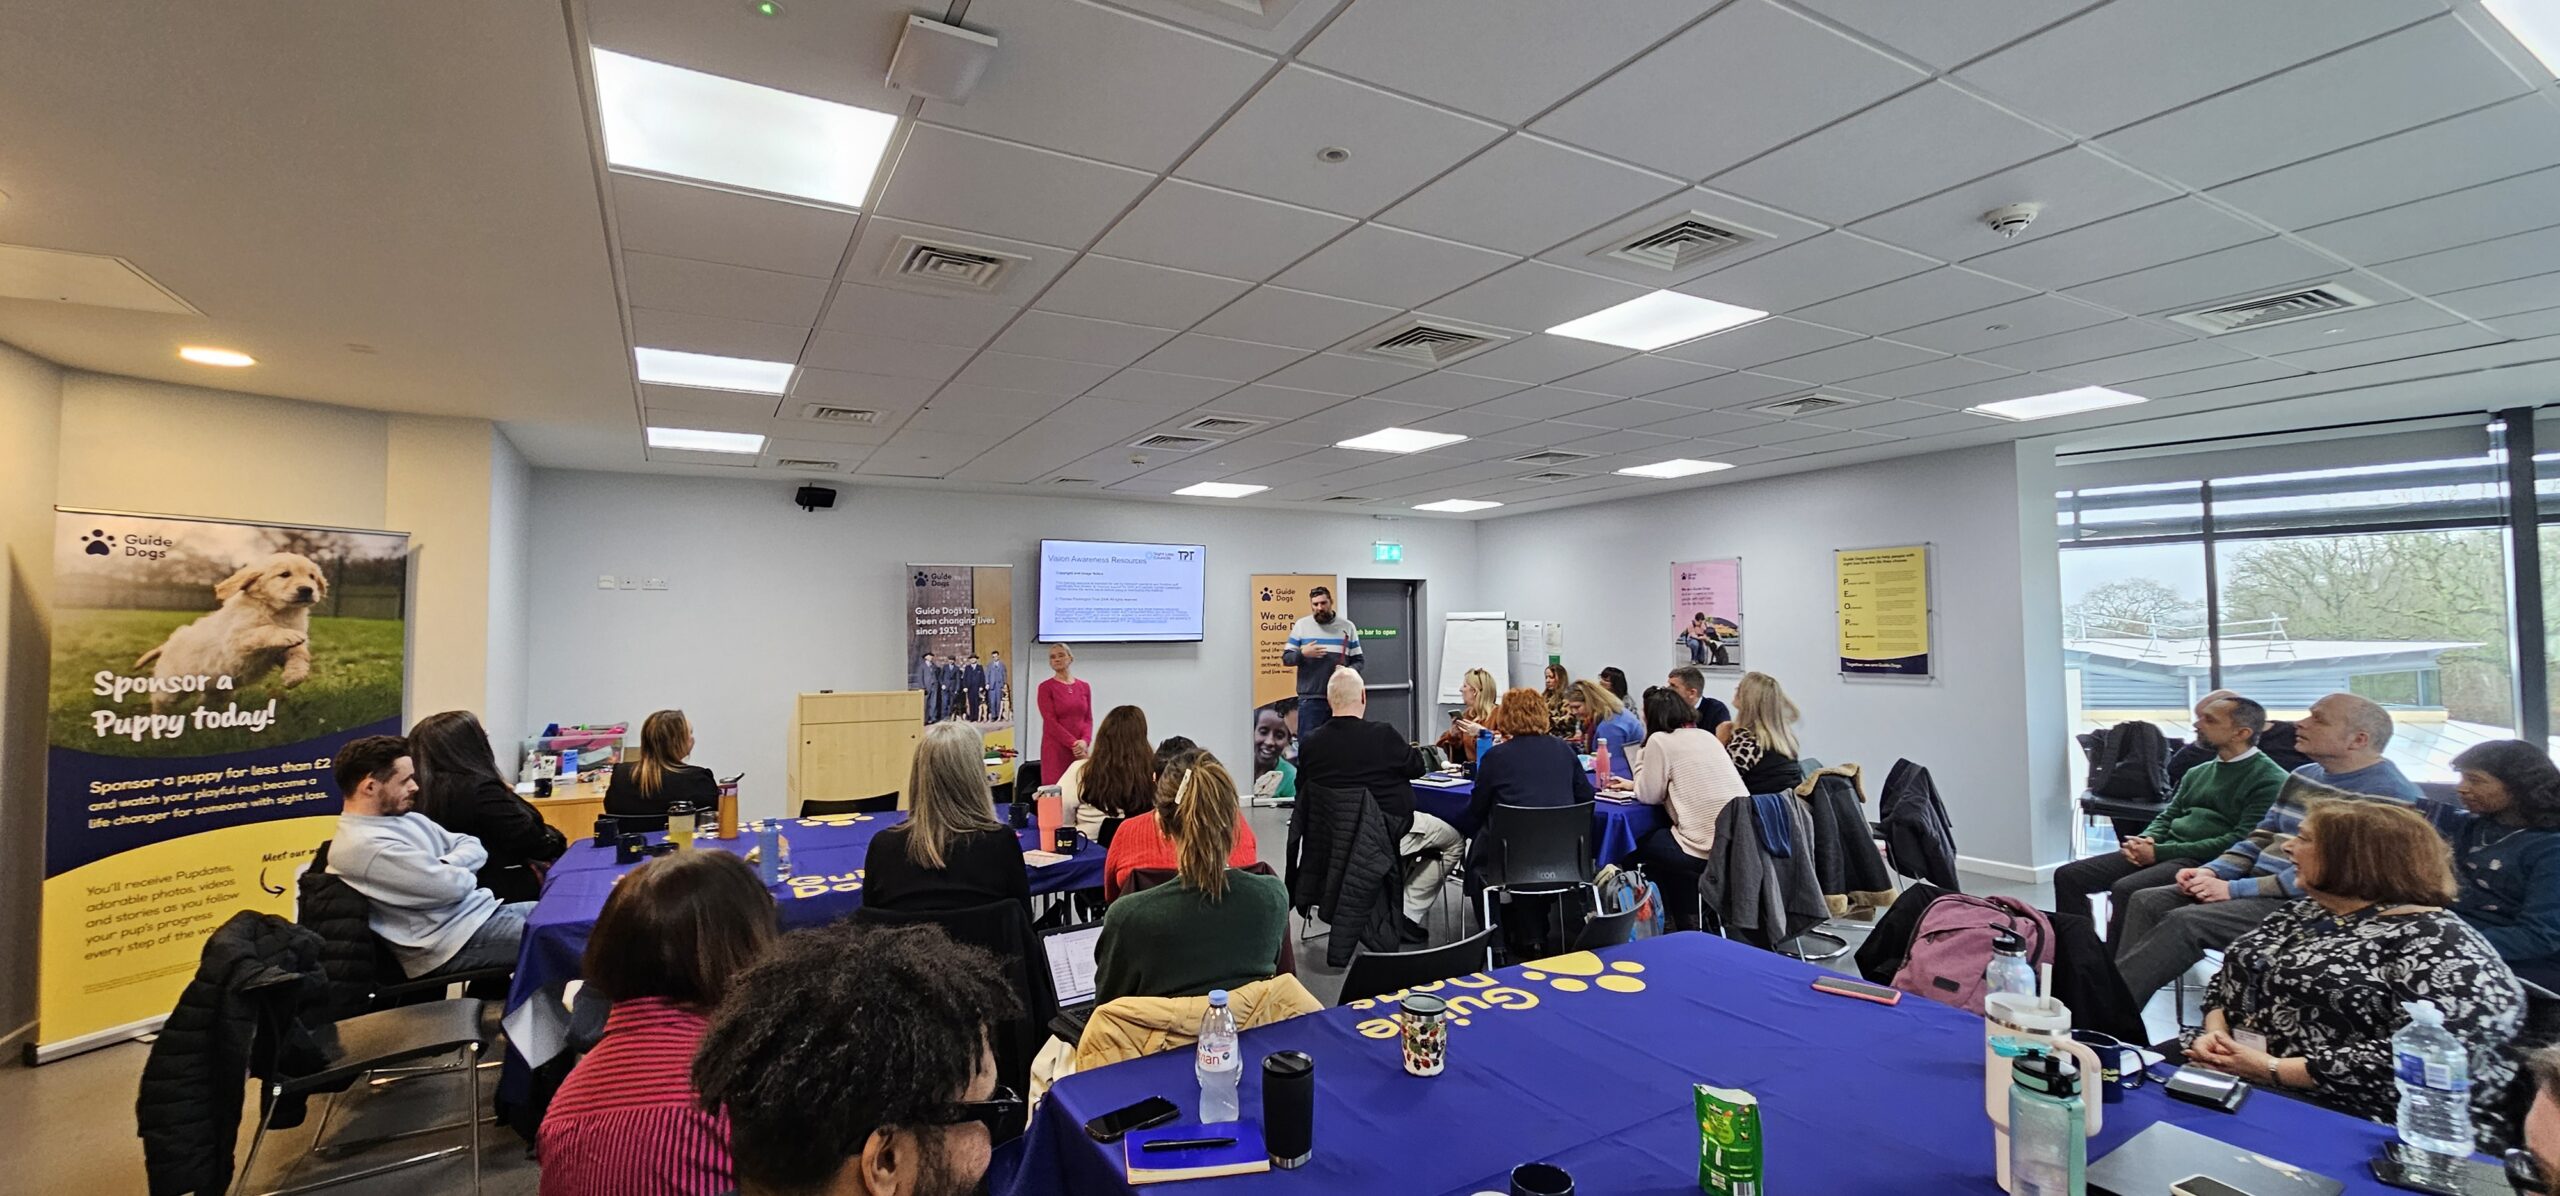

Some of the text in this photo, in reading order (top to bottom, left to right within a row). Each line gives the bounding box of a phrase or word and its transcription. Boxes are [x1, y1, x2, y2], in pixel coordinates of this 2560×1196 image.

[124, 534, 173, 547] Guide
[125, 547, 166, 560] Dogs
[1048, 554, 1147, 565] Vision Awareness Resources
[931, 580, 950, 588] Dogs
[915, 607, 940, 615] Guide
[942, 607, 962, 616] Dogs
[915, 617, 937, 625] been
[938, 617, 976, 626] changing
[1260, 612, 1276, 620] We
[916, 627, 937, 635] since
[1260, 622, 1287, 631] Guide
[92, 671, 233, 703] Sponsor a
[90, 699, 276, 742] Puppy today!
[89, 758, 331, 795] Sponsor a puppy for less than £2
[88, 799, 117, 811] and
[118, 794, 160, 807] watch
[162, 792, 193, 805] your
[194, 785, 236, 801] playful
[237, 784, 261, 795] pup
[262, 779, 307, 790] become
[88, 791, 328, 829] life changer for someone with sight loss.
[261, 850, 288, 862] Meet
[289, 849, 306, 859] our
[86, 865, 234, 896] You'll receive Pupdates,
[86, 877, 236, 912] adorable photos, videos
[85, 892, 241, 928] and stories as you follow
[85, 911, 214, 947] your pup's progress
[84, 926, 217, 961] every step of the wa
